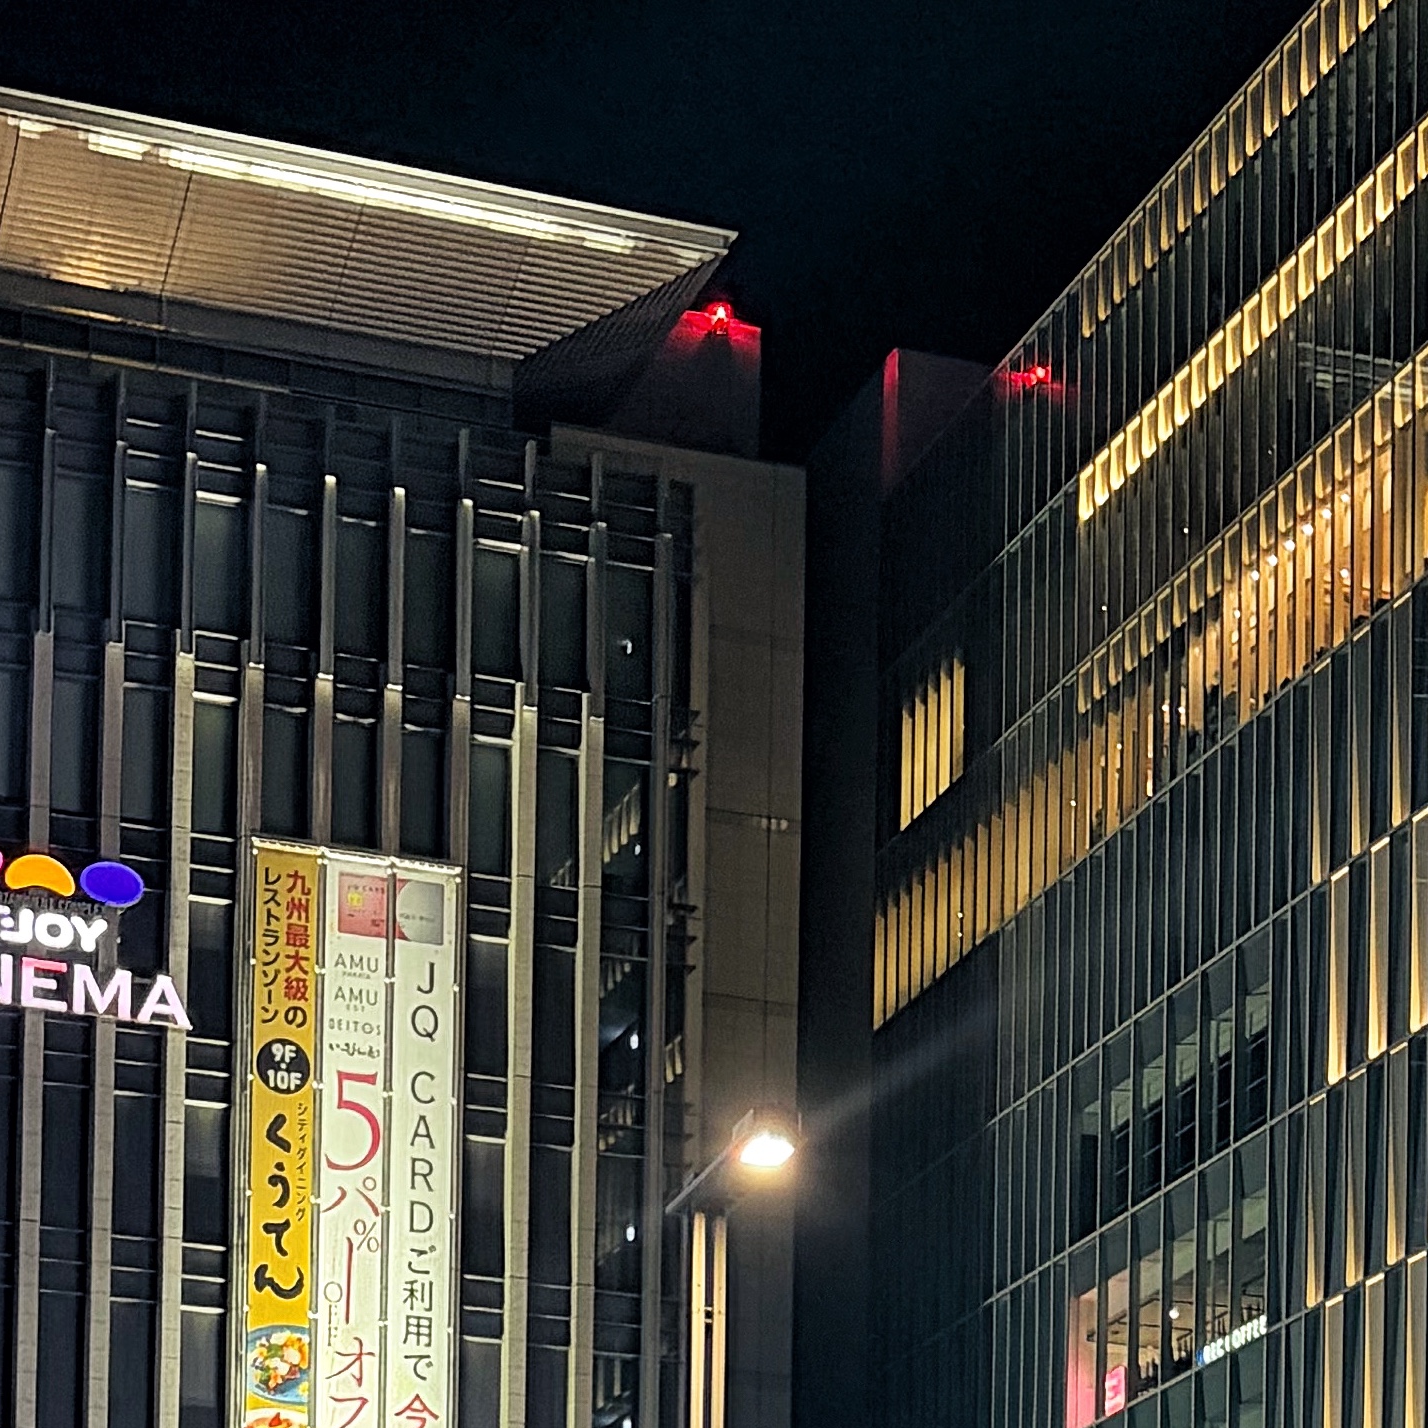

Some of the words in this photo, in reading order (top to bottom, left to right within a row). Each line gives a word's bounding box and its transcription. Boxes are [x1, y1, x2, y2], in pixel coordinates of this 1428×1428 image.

[261, 866, 282, 1025] レストランゾーン
[283, 869, 312, 1029] 九州最大級の
[334, 953, 380, 974] AMU
[334, 986, 379, 1006] AMU
[271, 1045, 297, 1064] 9F
[267, 1070, 302, 1090] 10F
[254, 1113, 305, 1300] くうてん
